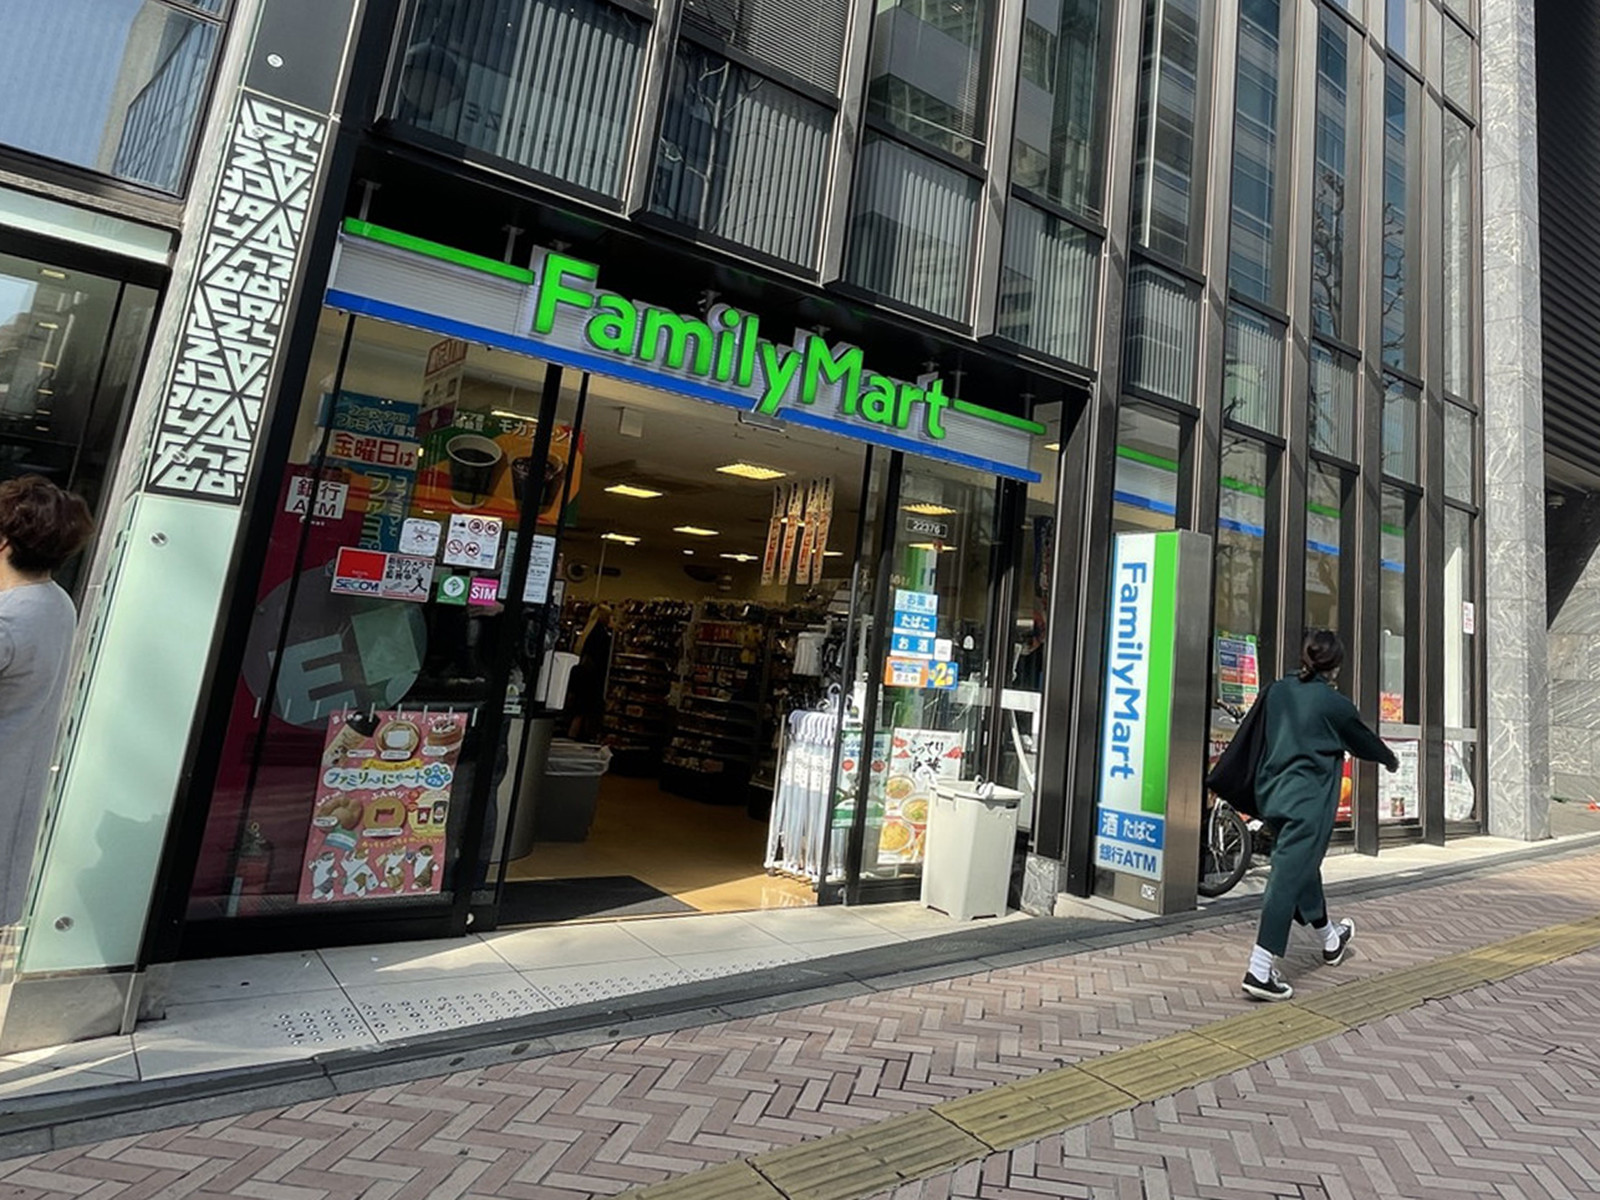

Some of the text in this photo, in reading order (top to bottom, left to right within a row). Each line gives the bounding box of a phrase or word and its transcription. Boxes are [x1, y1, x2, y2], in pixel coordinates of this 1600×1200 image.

[533, 251, 949, 440] FamilyMart
[331, 432, 416, 467] 金曜日は
[297, 478, 341, 501] 銀行
[293, 500, 336, 517] AM
[336, 578, 380, 592] SECOM
[471, 586, 497, 601] SIM
[900, 614, 930, 630] たばこ
[1110, 562, 1147, 780] FamilyMart
[910, 740, 944, 755] こってり
[1102, 812, 1156, 843] 酒 たばこ
[1099, 843, 1157, 873] 銀行ATM
